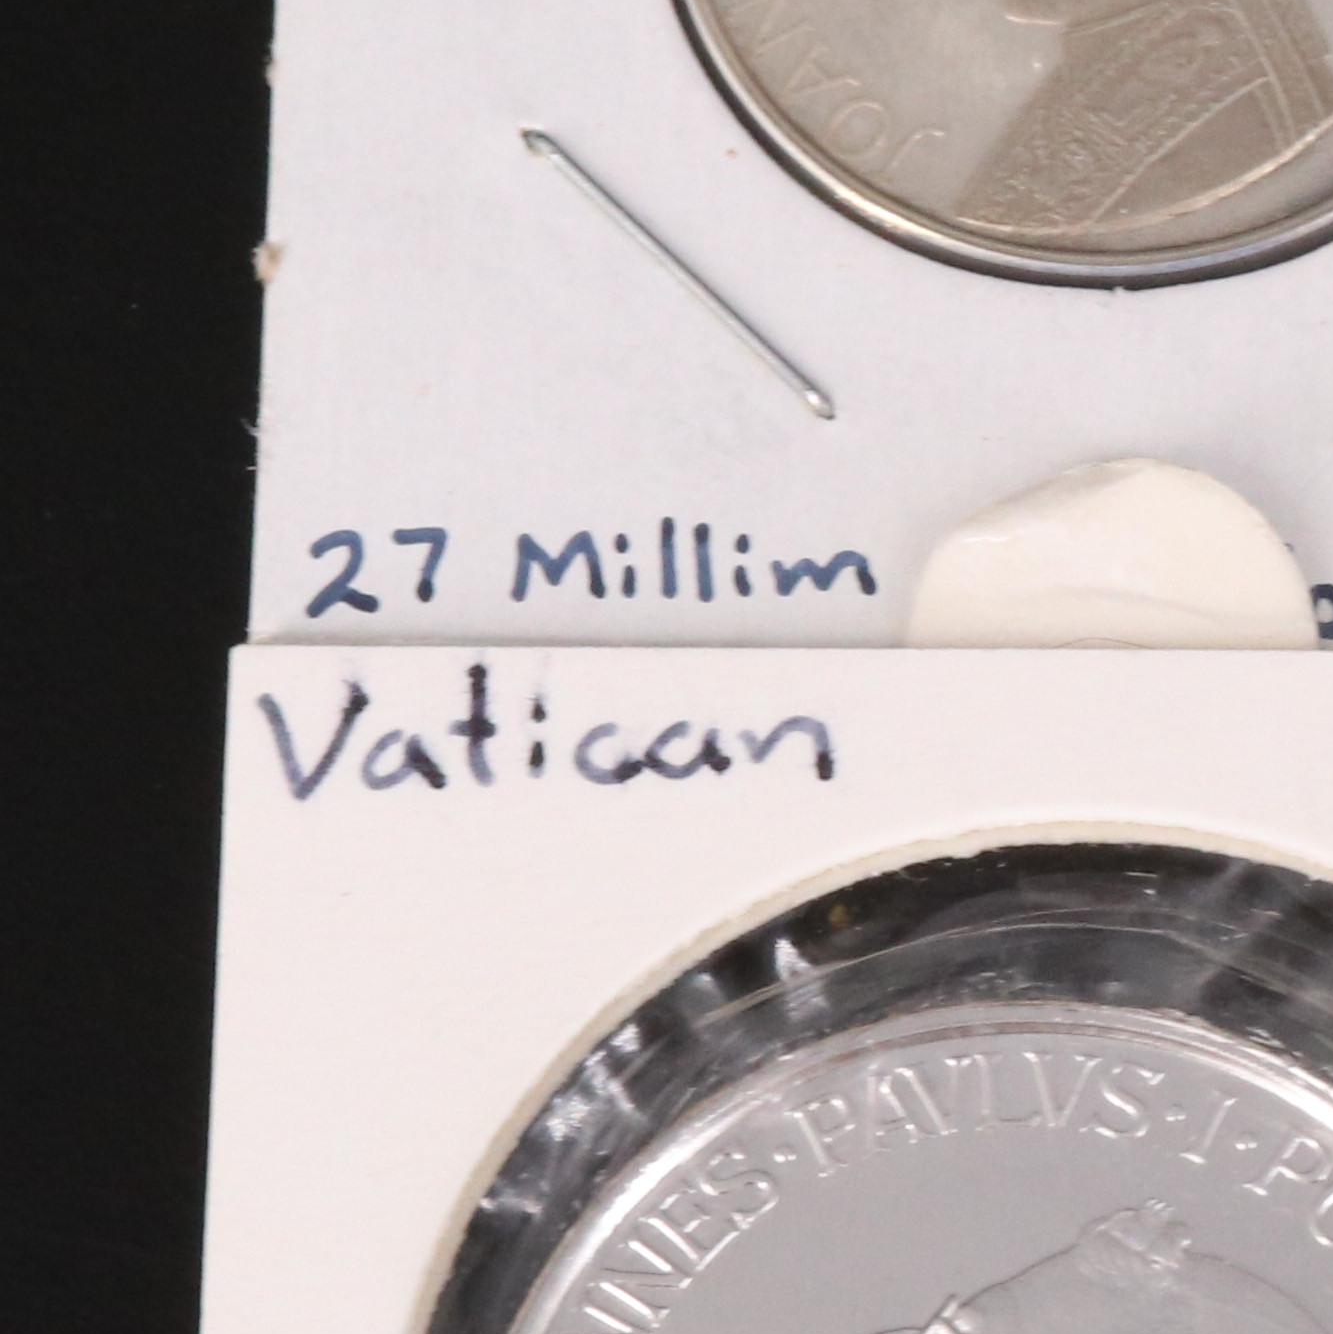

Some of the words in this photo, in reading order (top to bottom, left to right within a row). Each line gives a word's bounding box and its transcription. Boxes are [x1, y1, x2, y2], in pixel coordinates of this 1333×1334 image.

[305, 527, 448, 619] 27
[259, 663, 835, 800] Vatican
[784, 1051, 1166, 1179] PAVLVS
